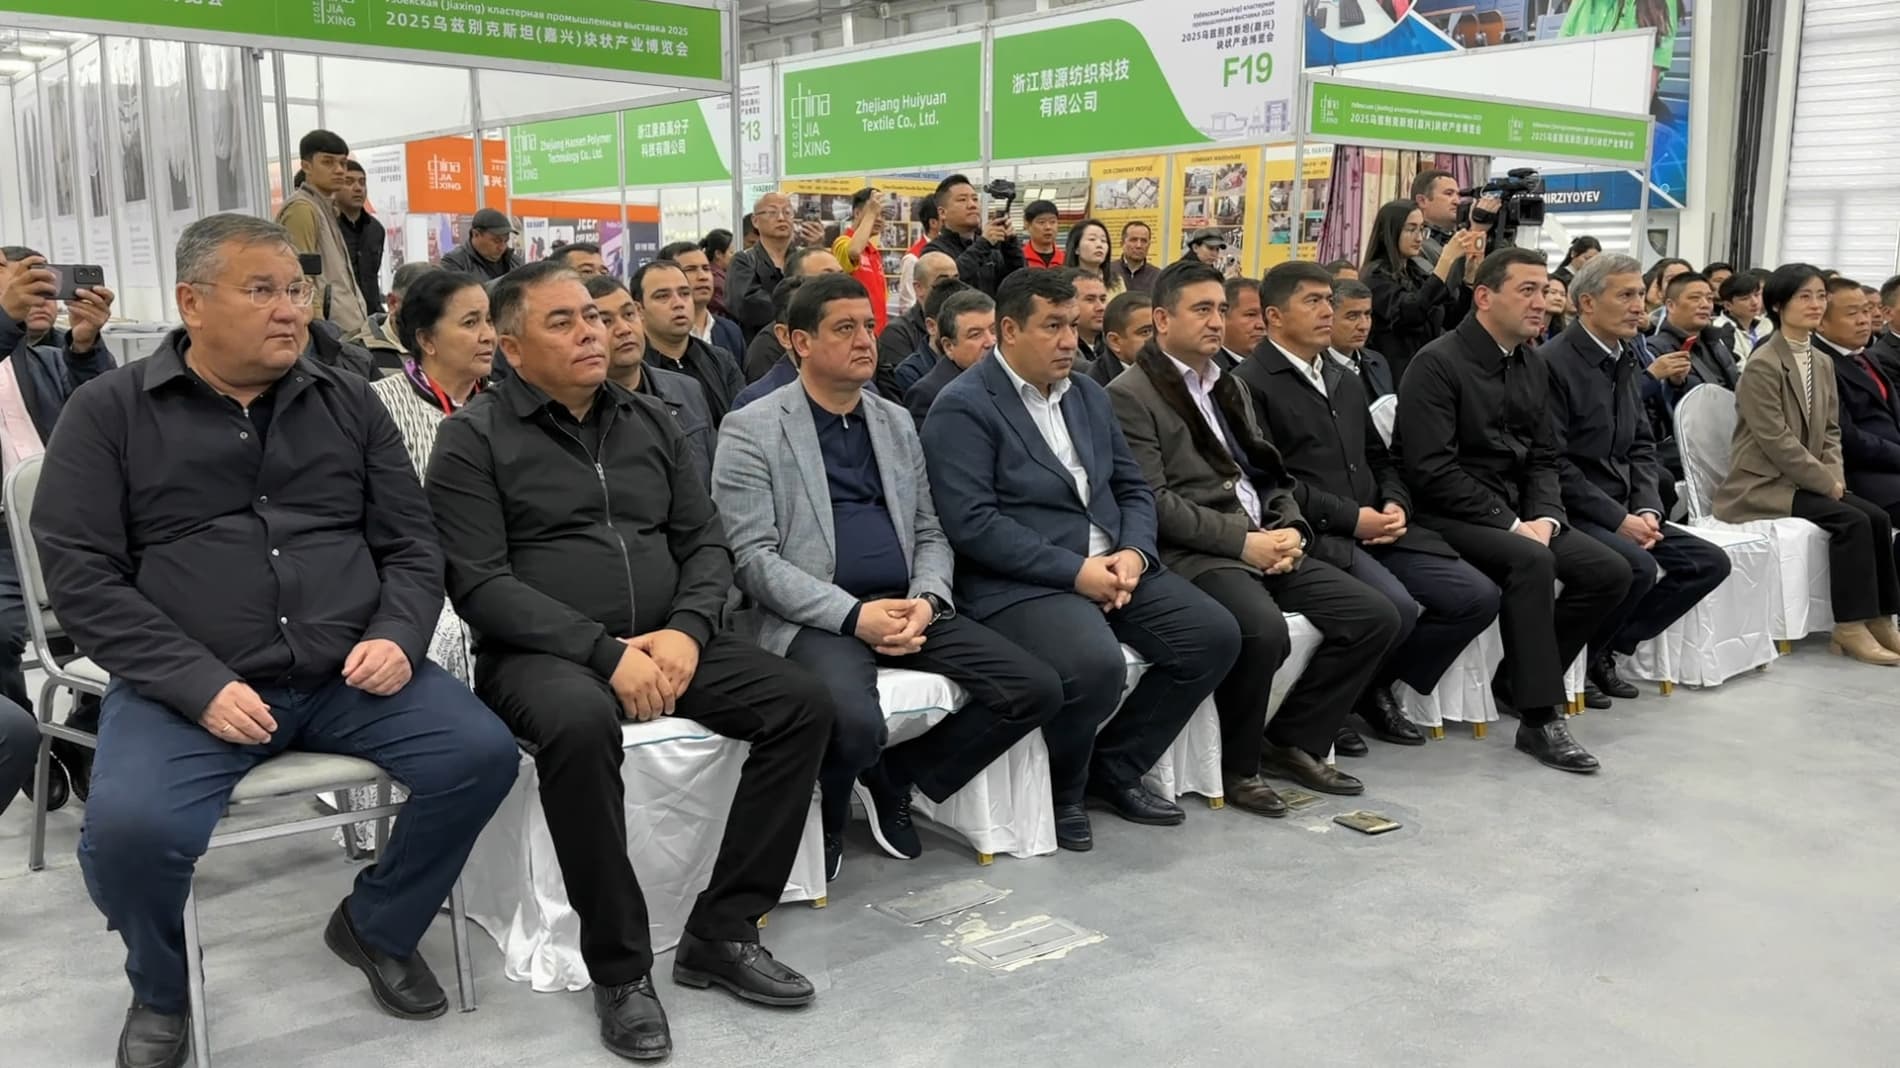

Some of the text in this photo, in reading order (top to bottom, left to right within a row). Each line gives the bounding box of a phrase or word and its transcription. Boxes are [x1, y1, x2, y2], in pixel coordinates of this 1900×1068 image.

[325, 3, 344, 14] JIA
[327, 15, 356, 27] XING
[546, 12, 622, 28] промышленная
[623, 21, 666, 33] выставка
[668, 25, 688, 36] 2025
[1012, 57, 1130, 95] 浙江慧源纺织科技
[1223, 52, 1273, 87] F19
[855, 91, 947, 115] Zhejiang Huiyuan
[1039, 90, 1098, 118] 有限公司
[803, 122, 820, 137] JIA
[862, 111, 939, 132] Textile Co., Ltd.
[804, 140, 831, 157] XING
